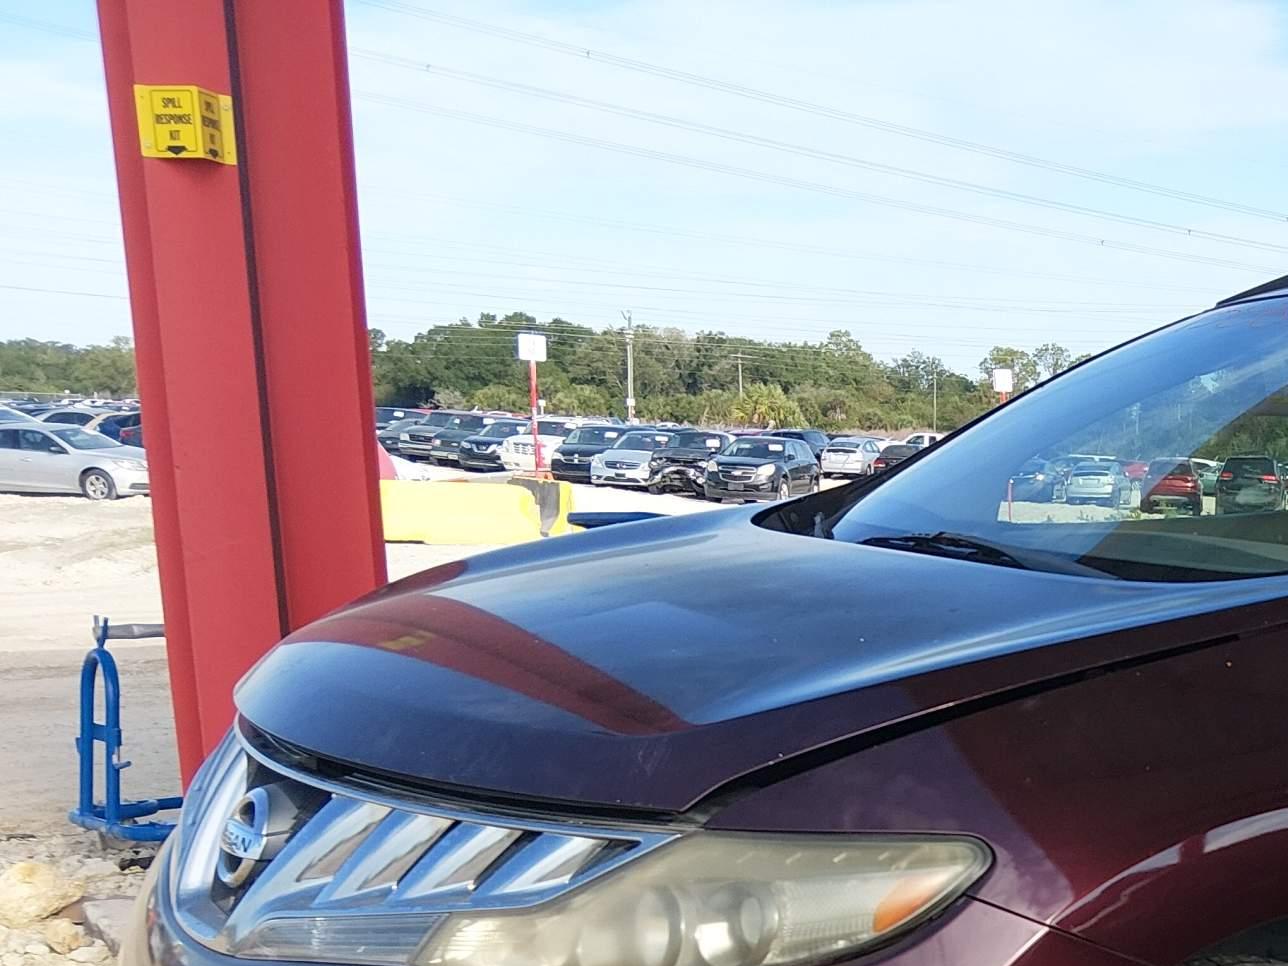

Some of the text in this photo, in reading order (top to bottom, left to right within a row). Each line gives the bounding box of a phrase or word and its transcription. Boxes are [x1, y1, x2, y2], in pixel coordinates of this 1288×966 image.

[161, 97, 182, 108] SPILL
[155, 113, 192, 125] RESPONSE
[168, 130, 180, 140] KIT
